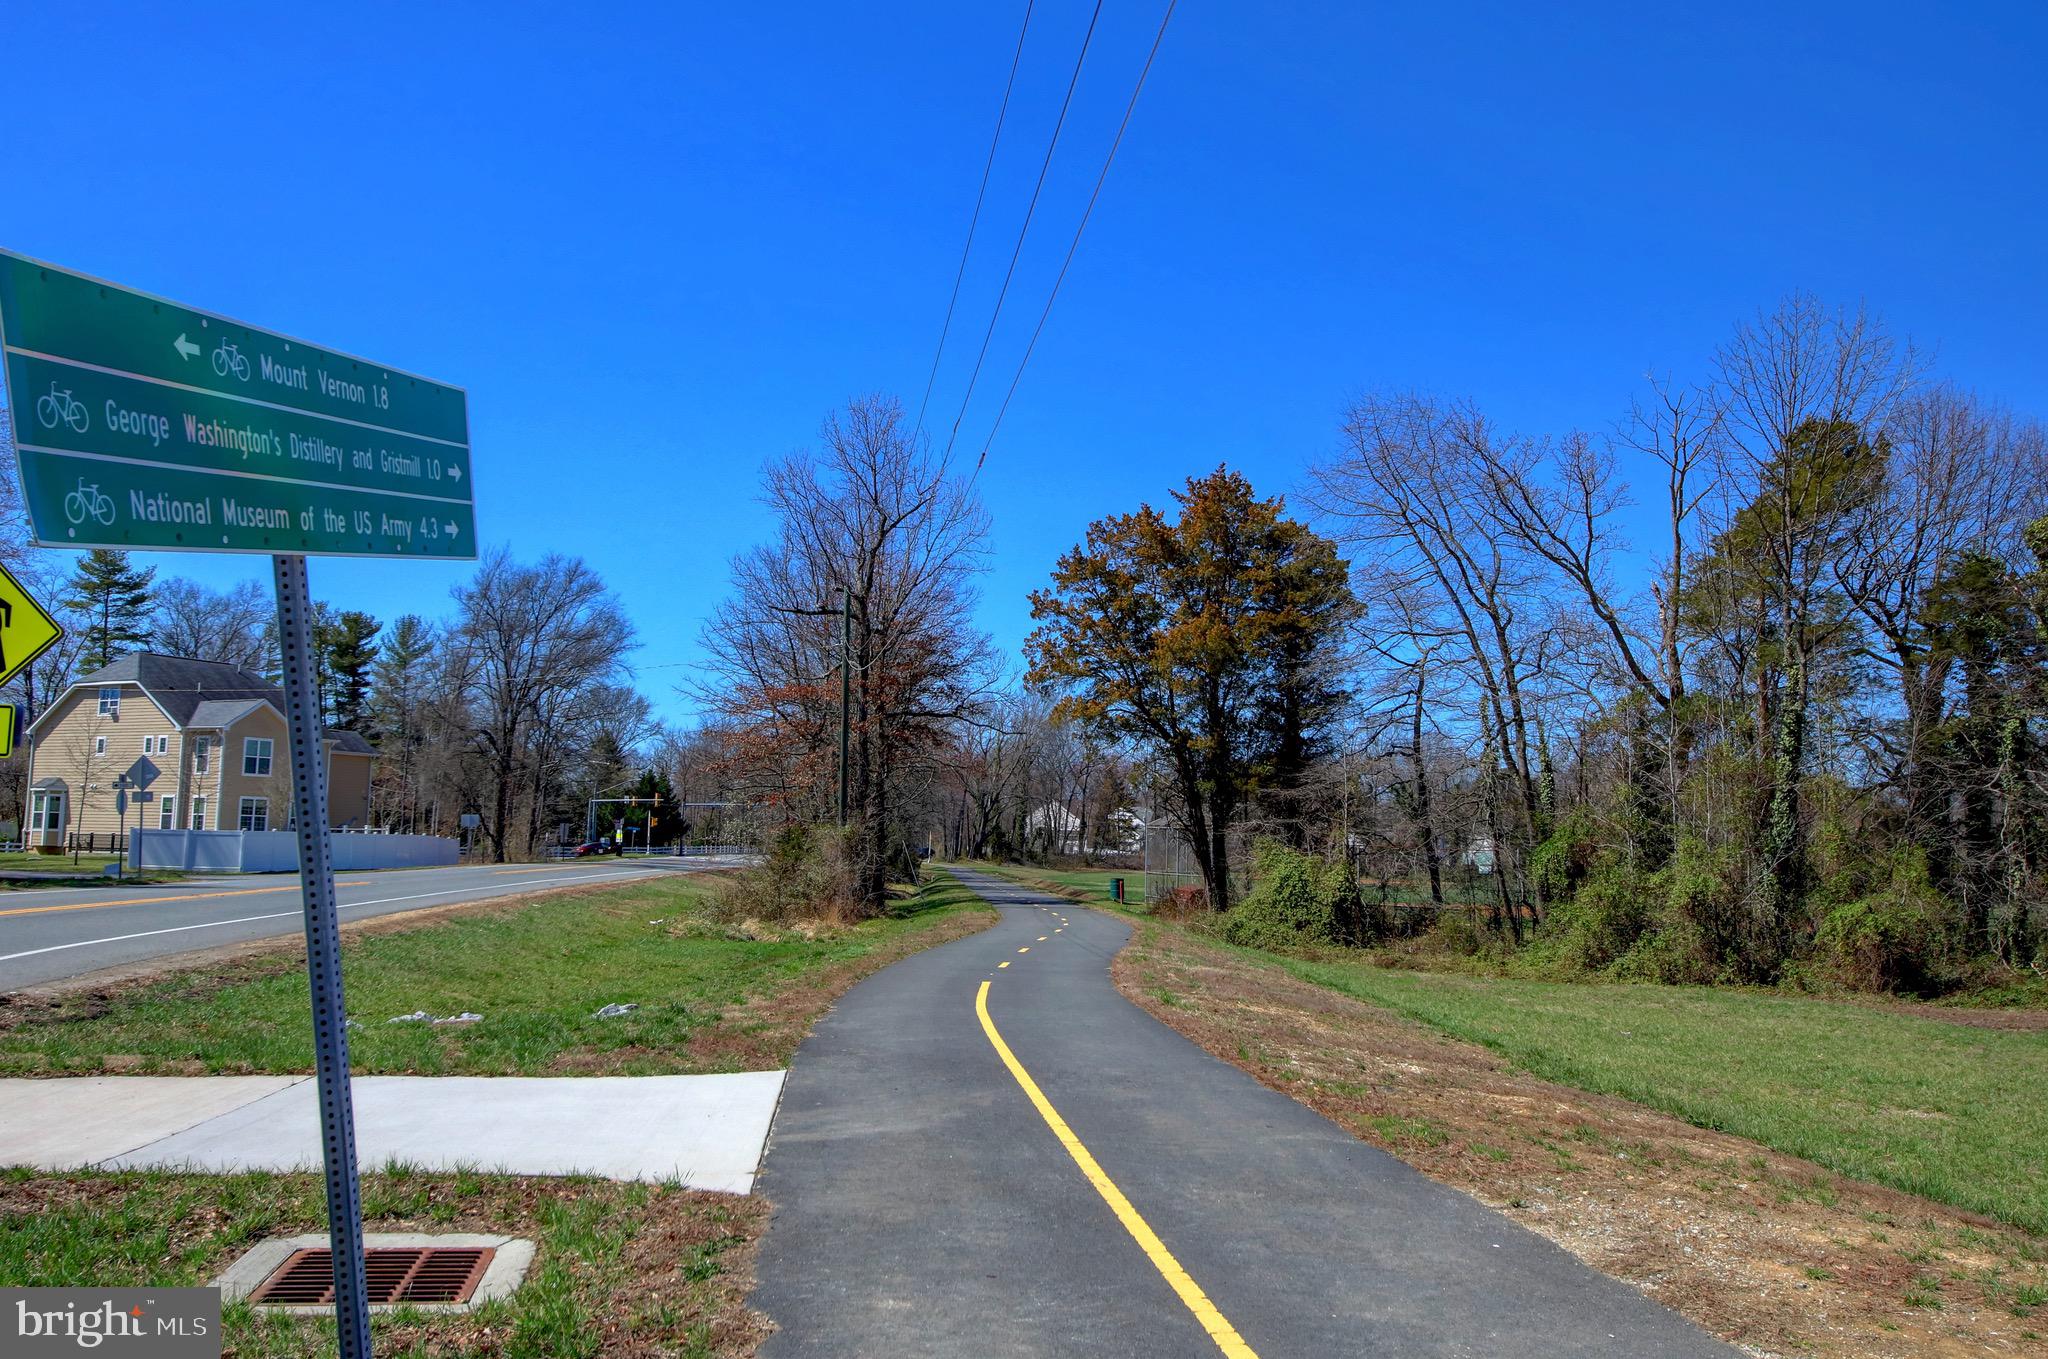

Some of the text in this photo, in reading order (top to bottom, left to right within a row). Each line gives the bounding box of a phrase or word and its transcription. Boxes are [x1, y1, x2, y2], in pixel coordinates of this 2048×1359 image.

[260, 354, 388, 410] Mount Vernon 1.8
[106, 400, 441, 480] George Washington's Distillery and Gristmill 1.0
[129, 490, 438, 542] National Museum of the US Army 4.3
